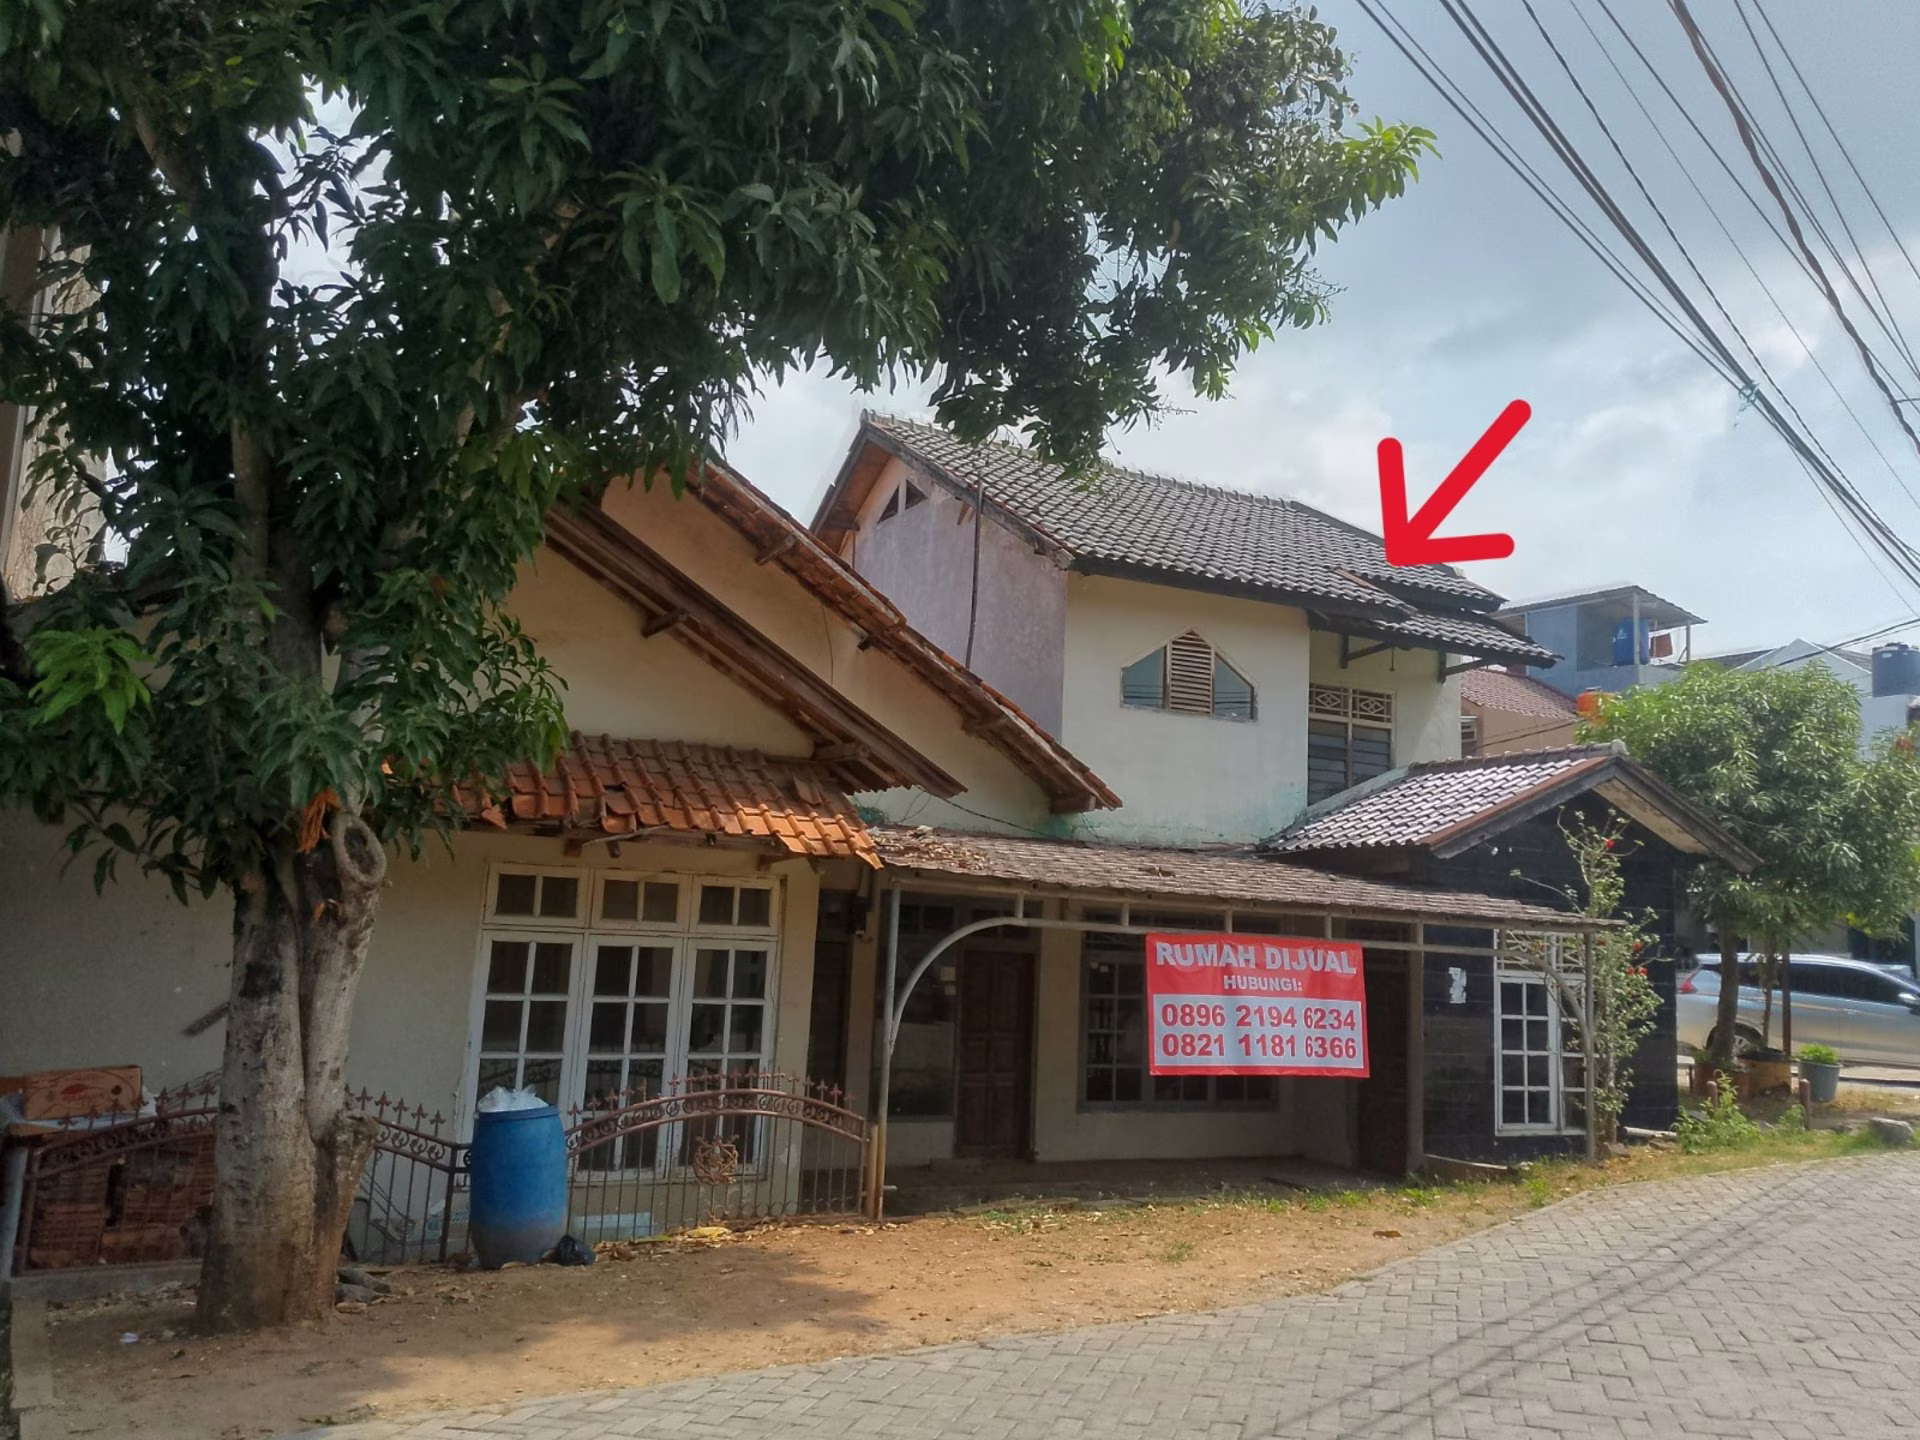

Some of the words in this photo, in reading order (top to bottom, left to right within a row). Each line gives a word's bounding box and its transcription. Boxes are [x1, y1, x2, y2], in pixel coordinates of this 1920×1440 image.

[1156, 941, 1256, 969] RUMAH
[1266, 947, 1357, 974] DIJUAL
[1224, 975, 1303, 991] HUBUNGI:
[1161, 1003, 1226, 1027] 0896
[1235, 1005, 1297, 1028] 2194
[1303, 1007, 1356, 1031] 6234
[1162, 1034, 1225, 1057] 0821
[1238, 1034, 1296, 1057] 1181
[1305, 1035, 1357, 1059] 6366
